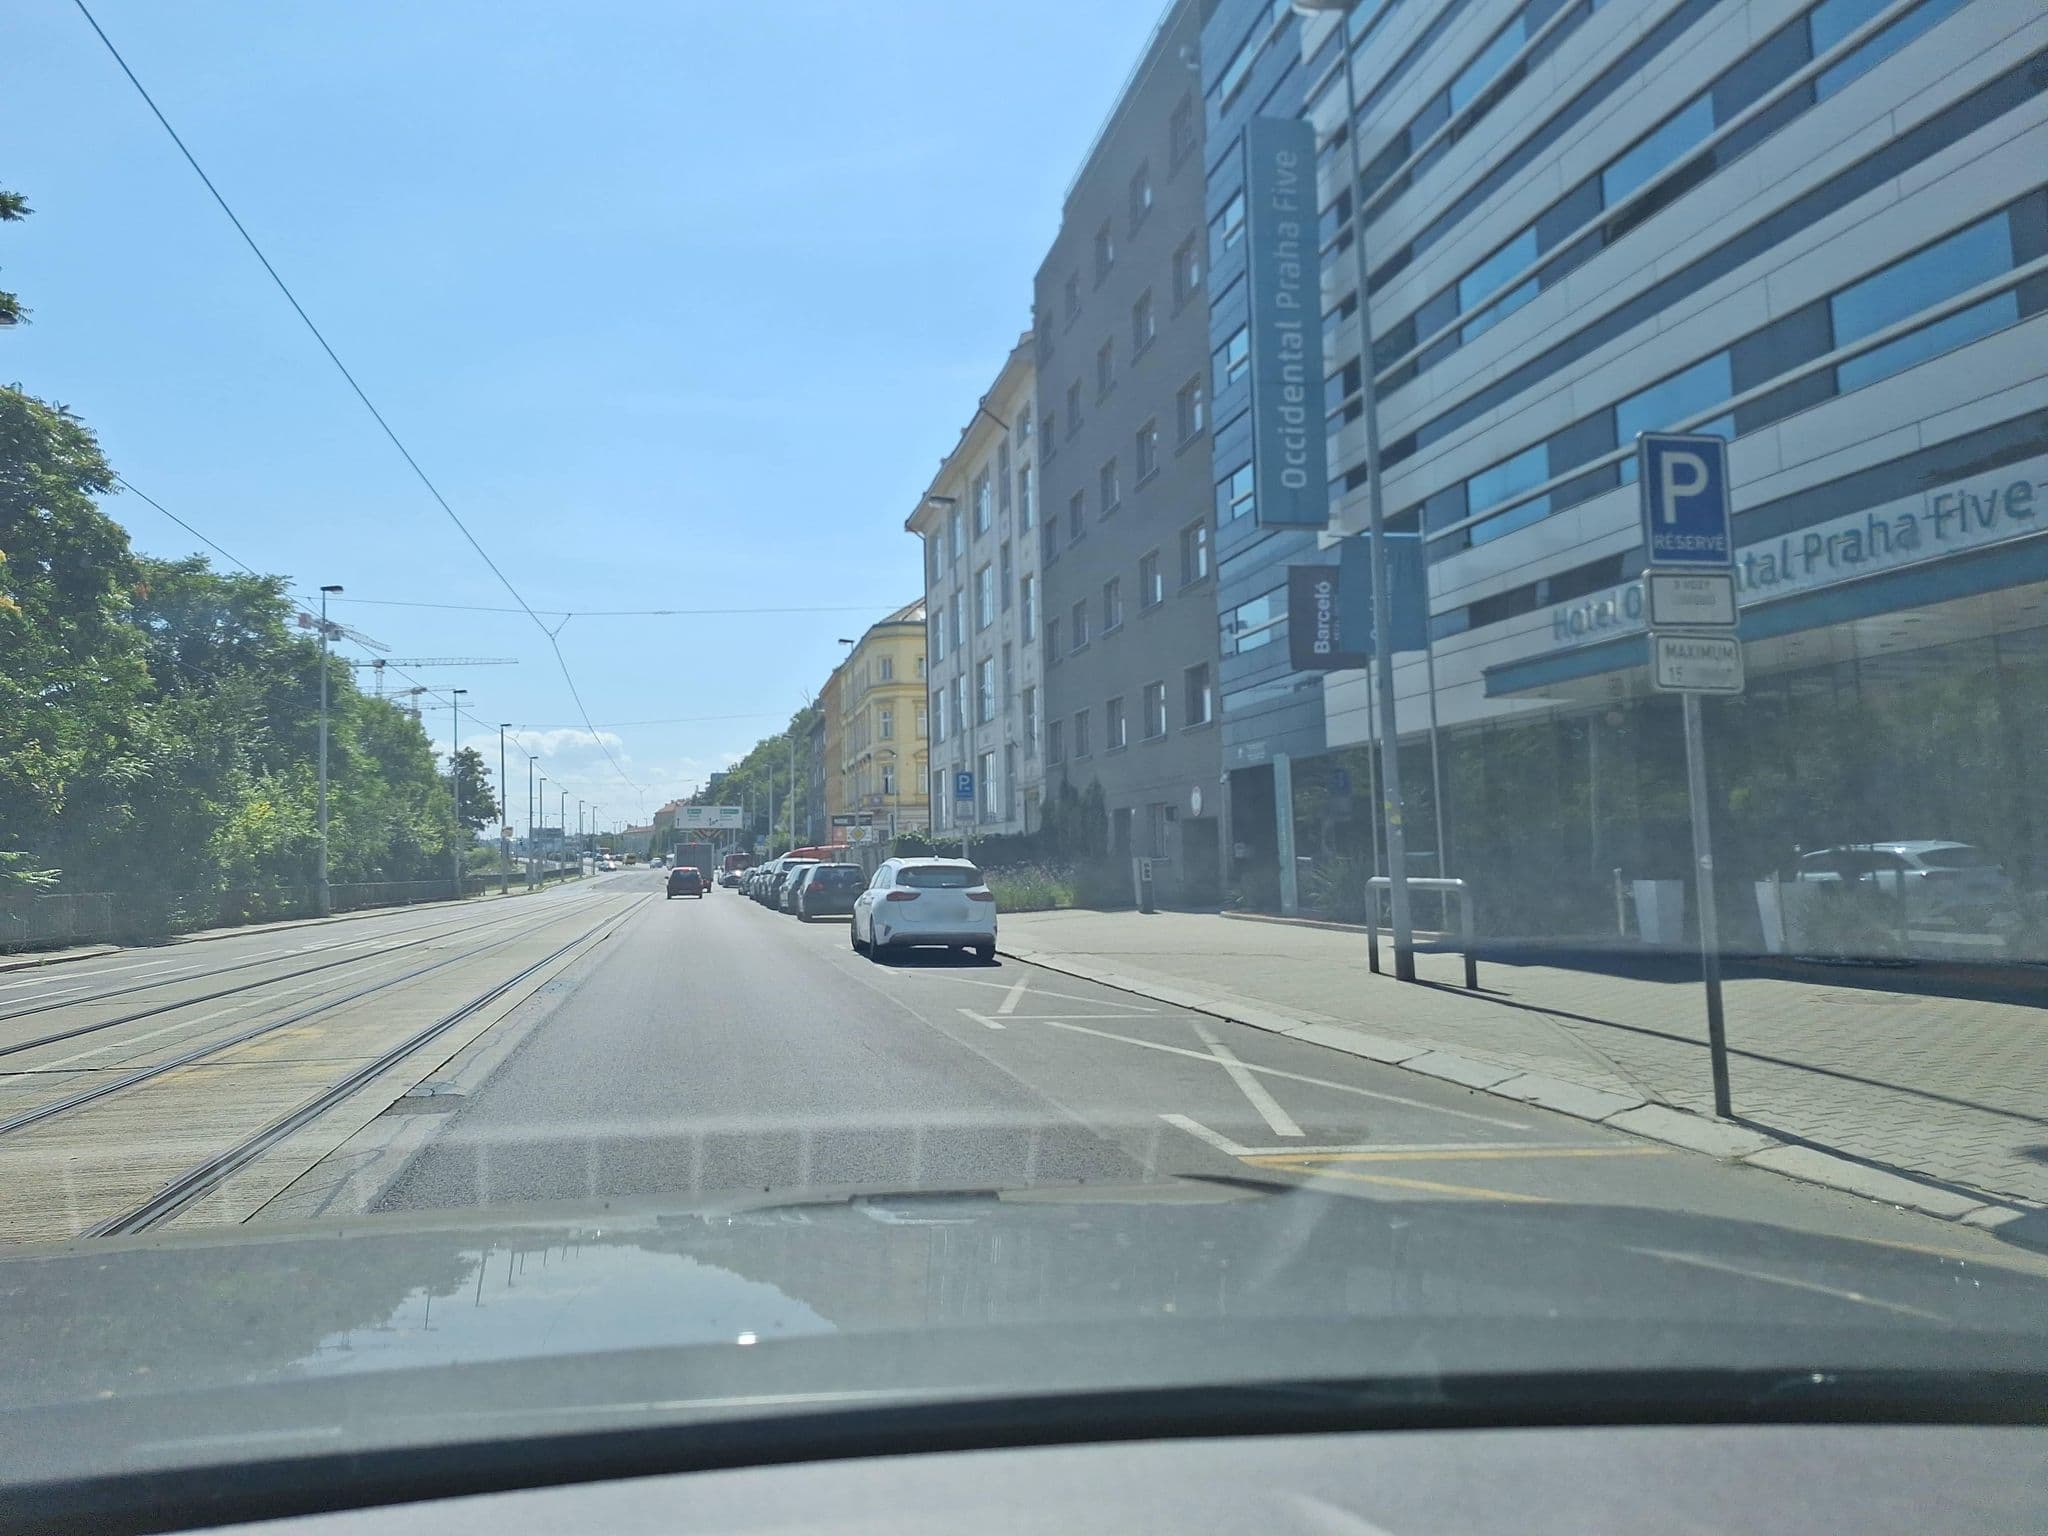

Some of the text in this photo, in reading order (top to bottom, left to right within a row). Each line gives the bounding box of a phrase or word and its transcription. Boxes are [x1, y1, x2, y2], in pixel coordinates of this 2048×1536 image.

[1272, 150, 1307, 489] Occidental Praha Five
[1660, 450, 1709, 525] P
[1552, 592, 1620, 641] Hotel
[1802, 513, 1922, 574] Praha
[1933, 480, 2035, 540] Five
[1313, 580, 1332, 655] Barceló
[1665, 643, 1735, 660] MAXIMUM
